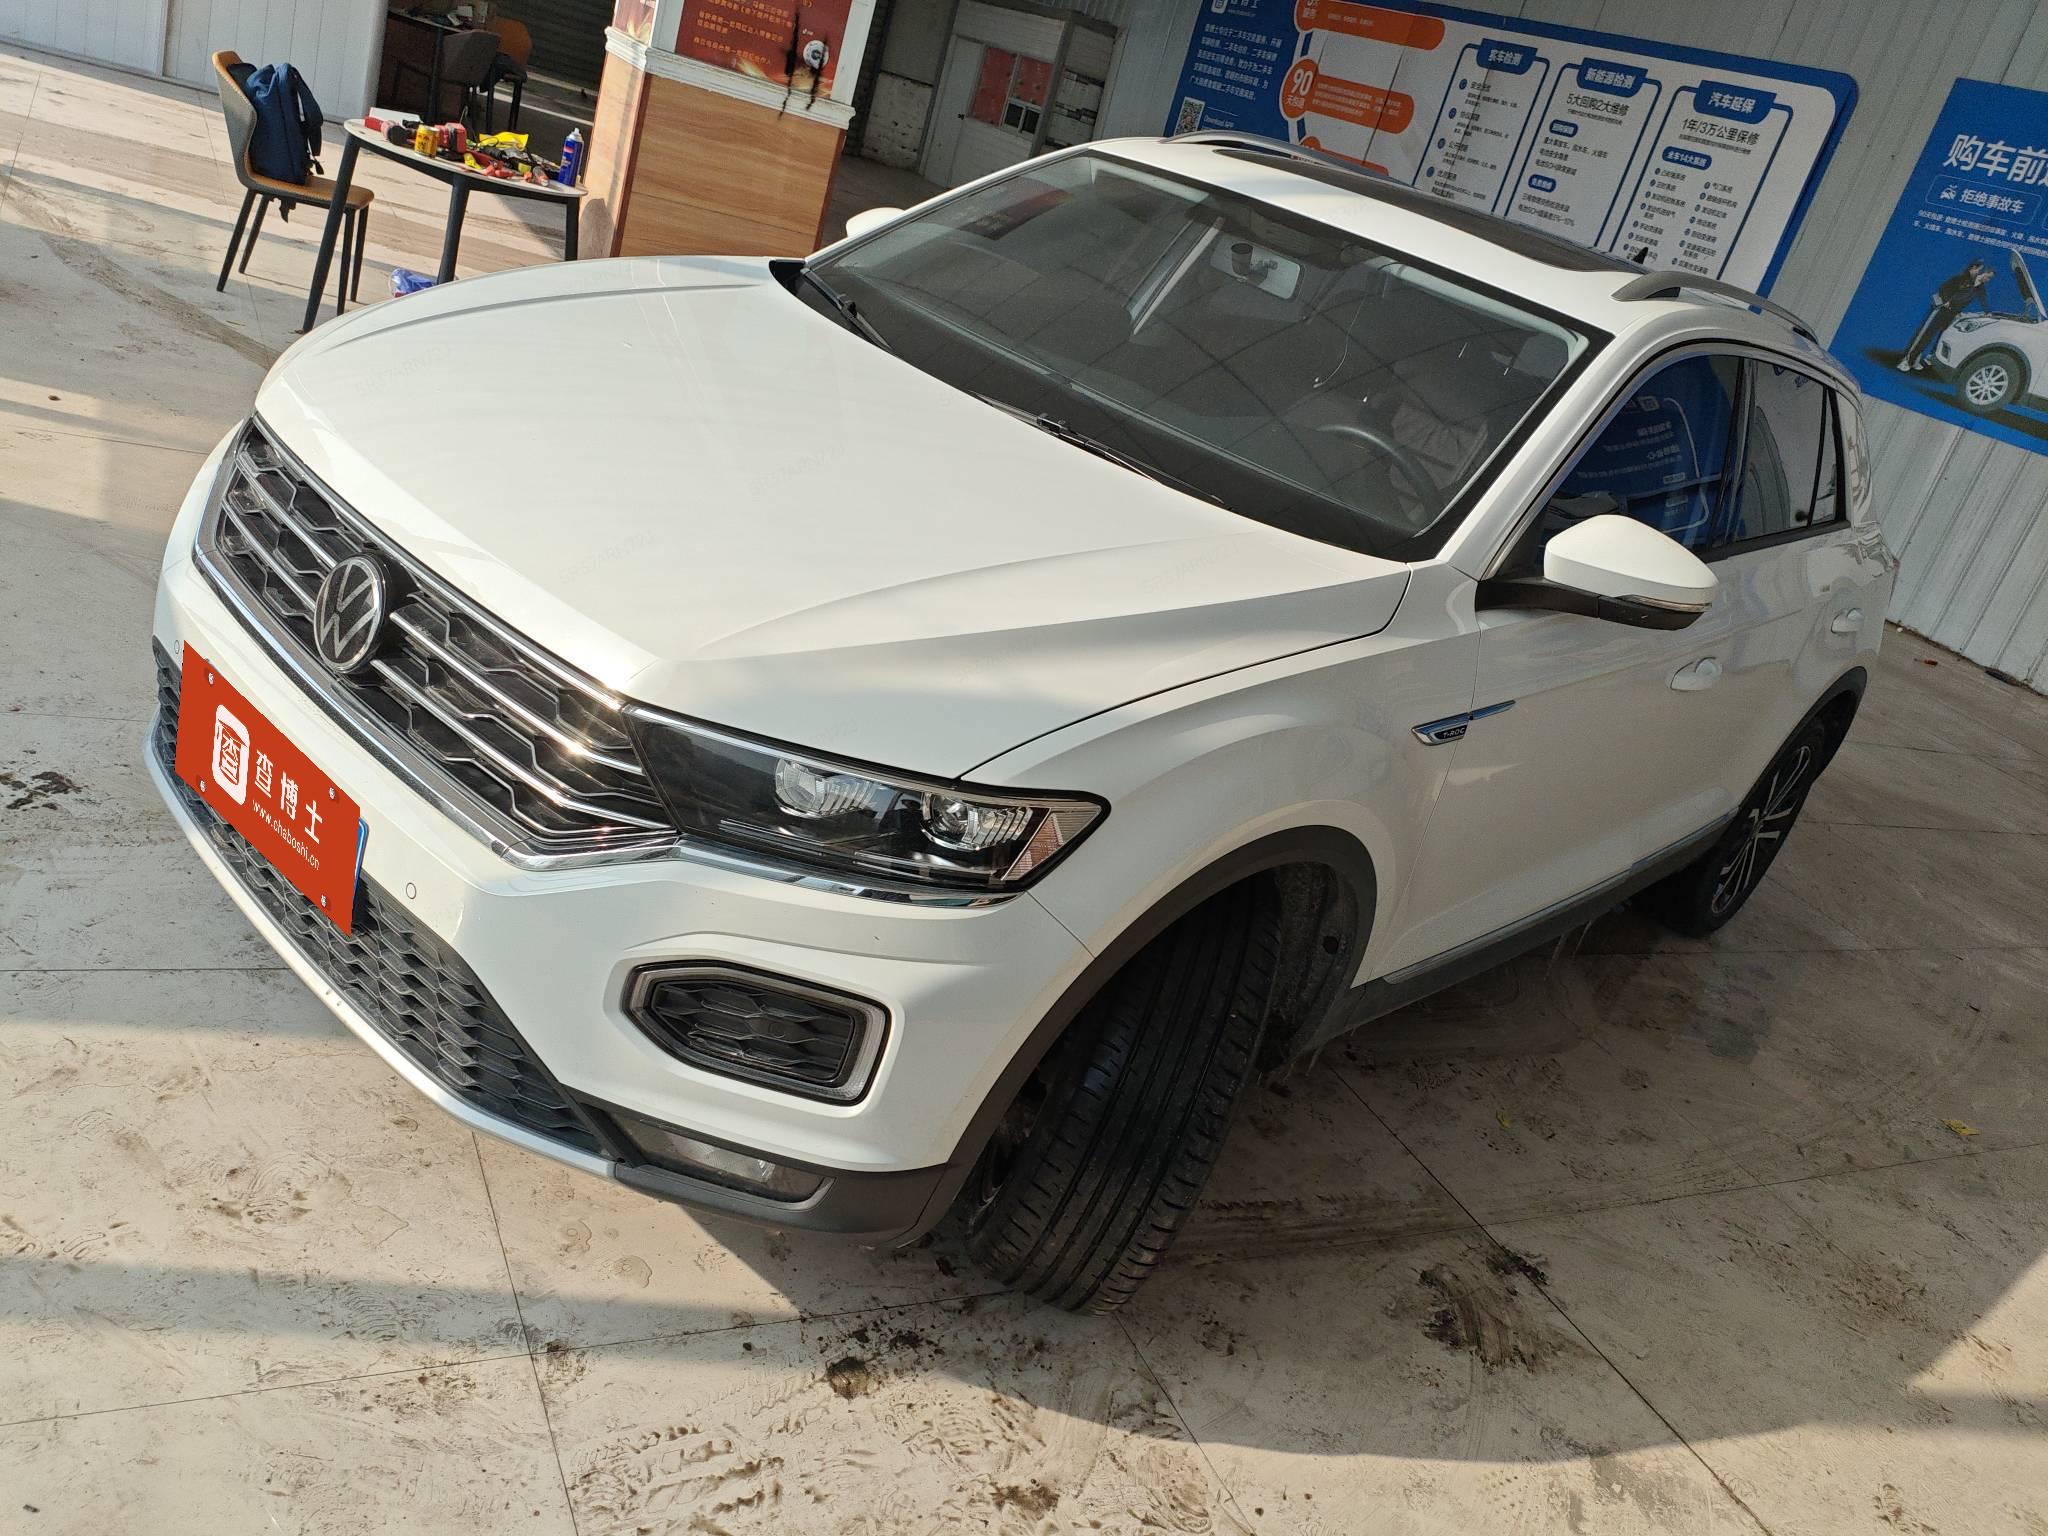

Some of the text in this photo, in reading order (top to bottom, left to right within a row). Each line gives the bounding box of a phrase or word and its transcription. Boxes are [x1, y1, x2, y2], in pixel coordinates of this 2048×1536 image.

[1291, 69, 1313, 96] 90
[1584, 67, 1636, 89] 新能源检测
[1566, 93, 1630, 116] 5大回购2大维修
[1708, 91, 1756, 114] 汽车延保
[1682, 118, 1760, 146] 1年/3万公里保修
[1942, 134, 2048, 187] 购车前
[1960, 188, 2025, 214] 拒绝事故车
[1442, 727, 1466, 739] T-ROC
